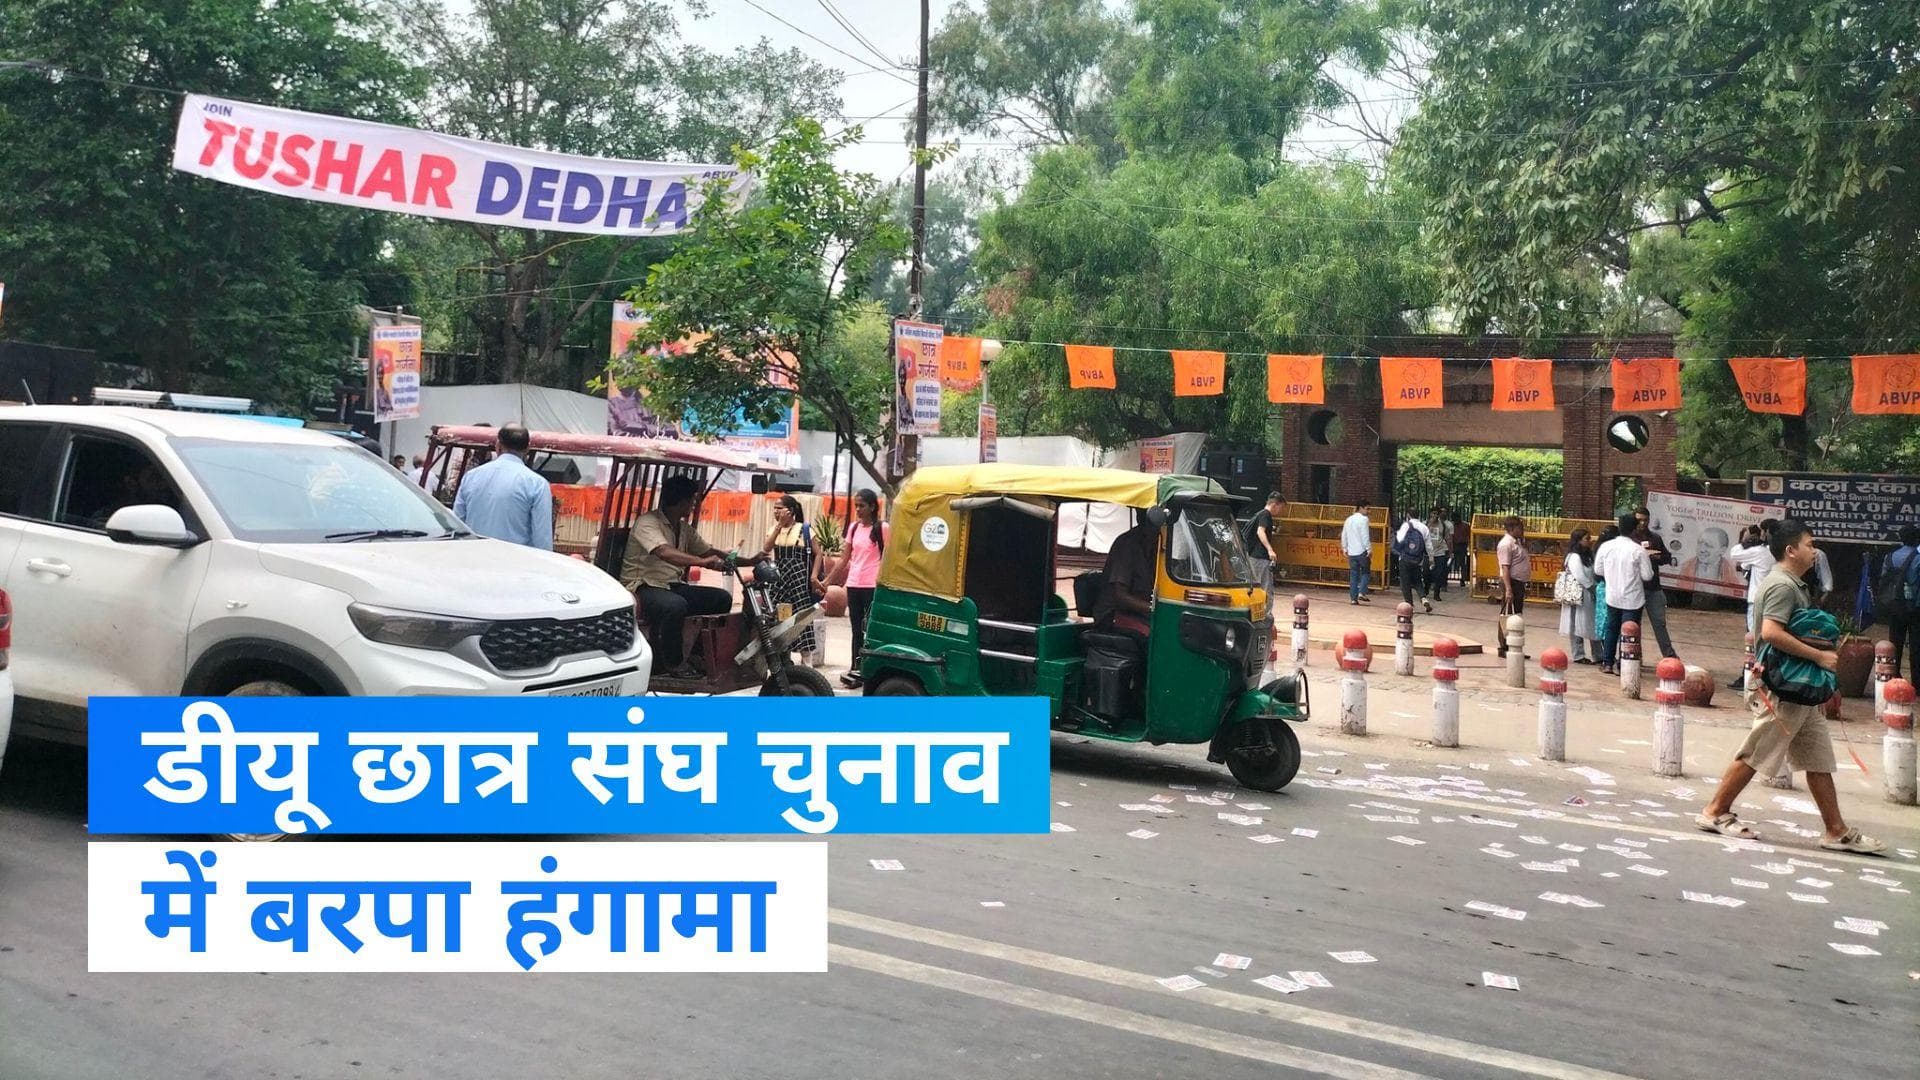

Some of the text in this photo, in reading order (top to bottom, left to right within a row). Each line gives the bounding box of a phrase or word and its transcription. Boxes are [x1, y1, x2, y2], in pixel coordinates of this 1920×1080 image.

[203, 102, 233, 117] JOIN
[200, 117, 688, 230] TUSHAR DEDHA
[1191, 376, 1216, 387] ABVP
[1285, 384, 1313, 396] ABVP
[1400, 387, 1431, 400] ABVP
[1508, 390, 1540, 403] ABVP
[1633, 389, 1667, 403] ABVP
[1788, 478, 1920, 495] कला संका
[1774, 498, 1861, 512] FACULTY
[1867, 502, 1894, 513] OF
[1791, 510, 1868, 520] UNIVERSITY
[1872, 513, 1890, 521] OF
[1812, 529, 1888, 541] ntenary
[1320, 542, 1344, 559] पुलि
